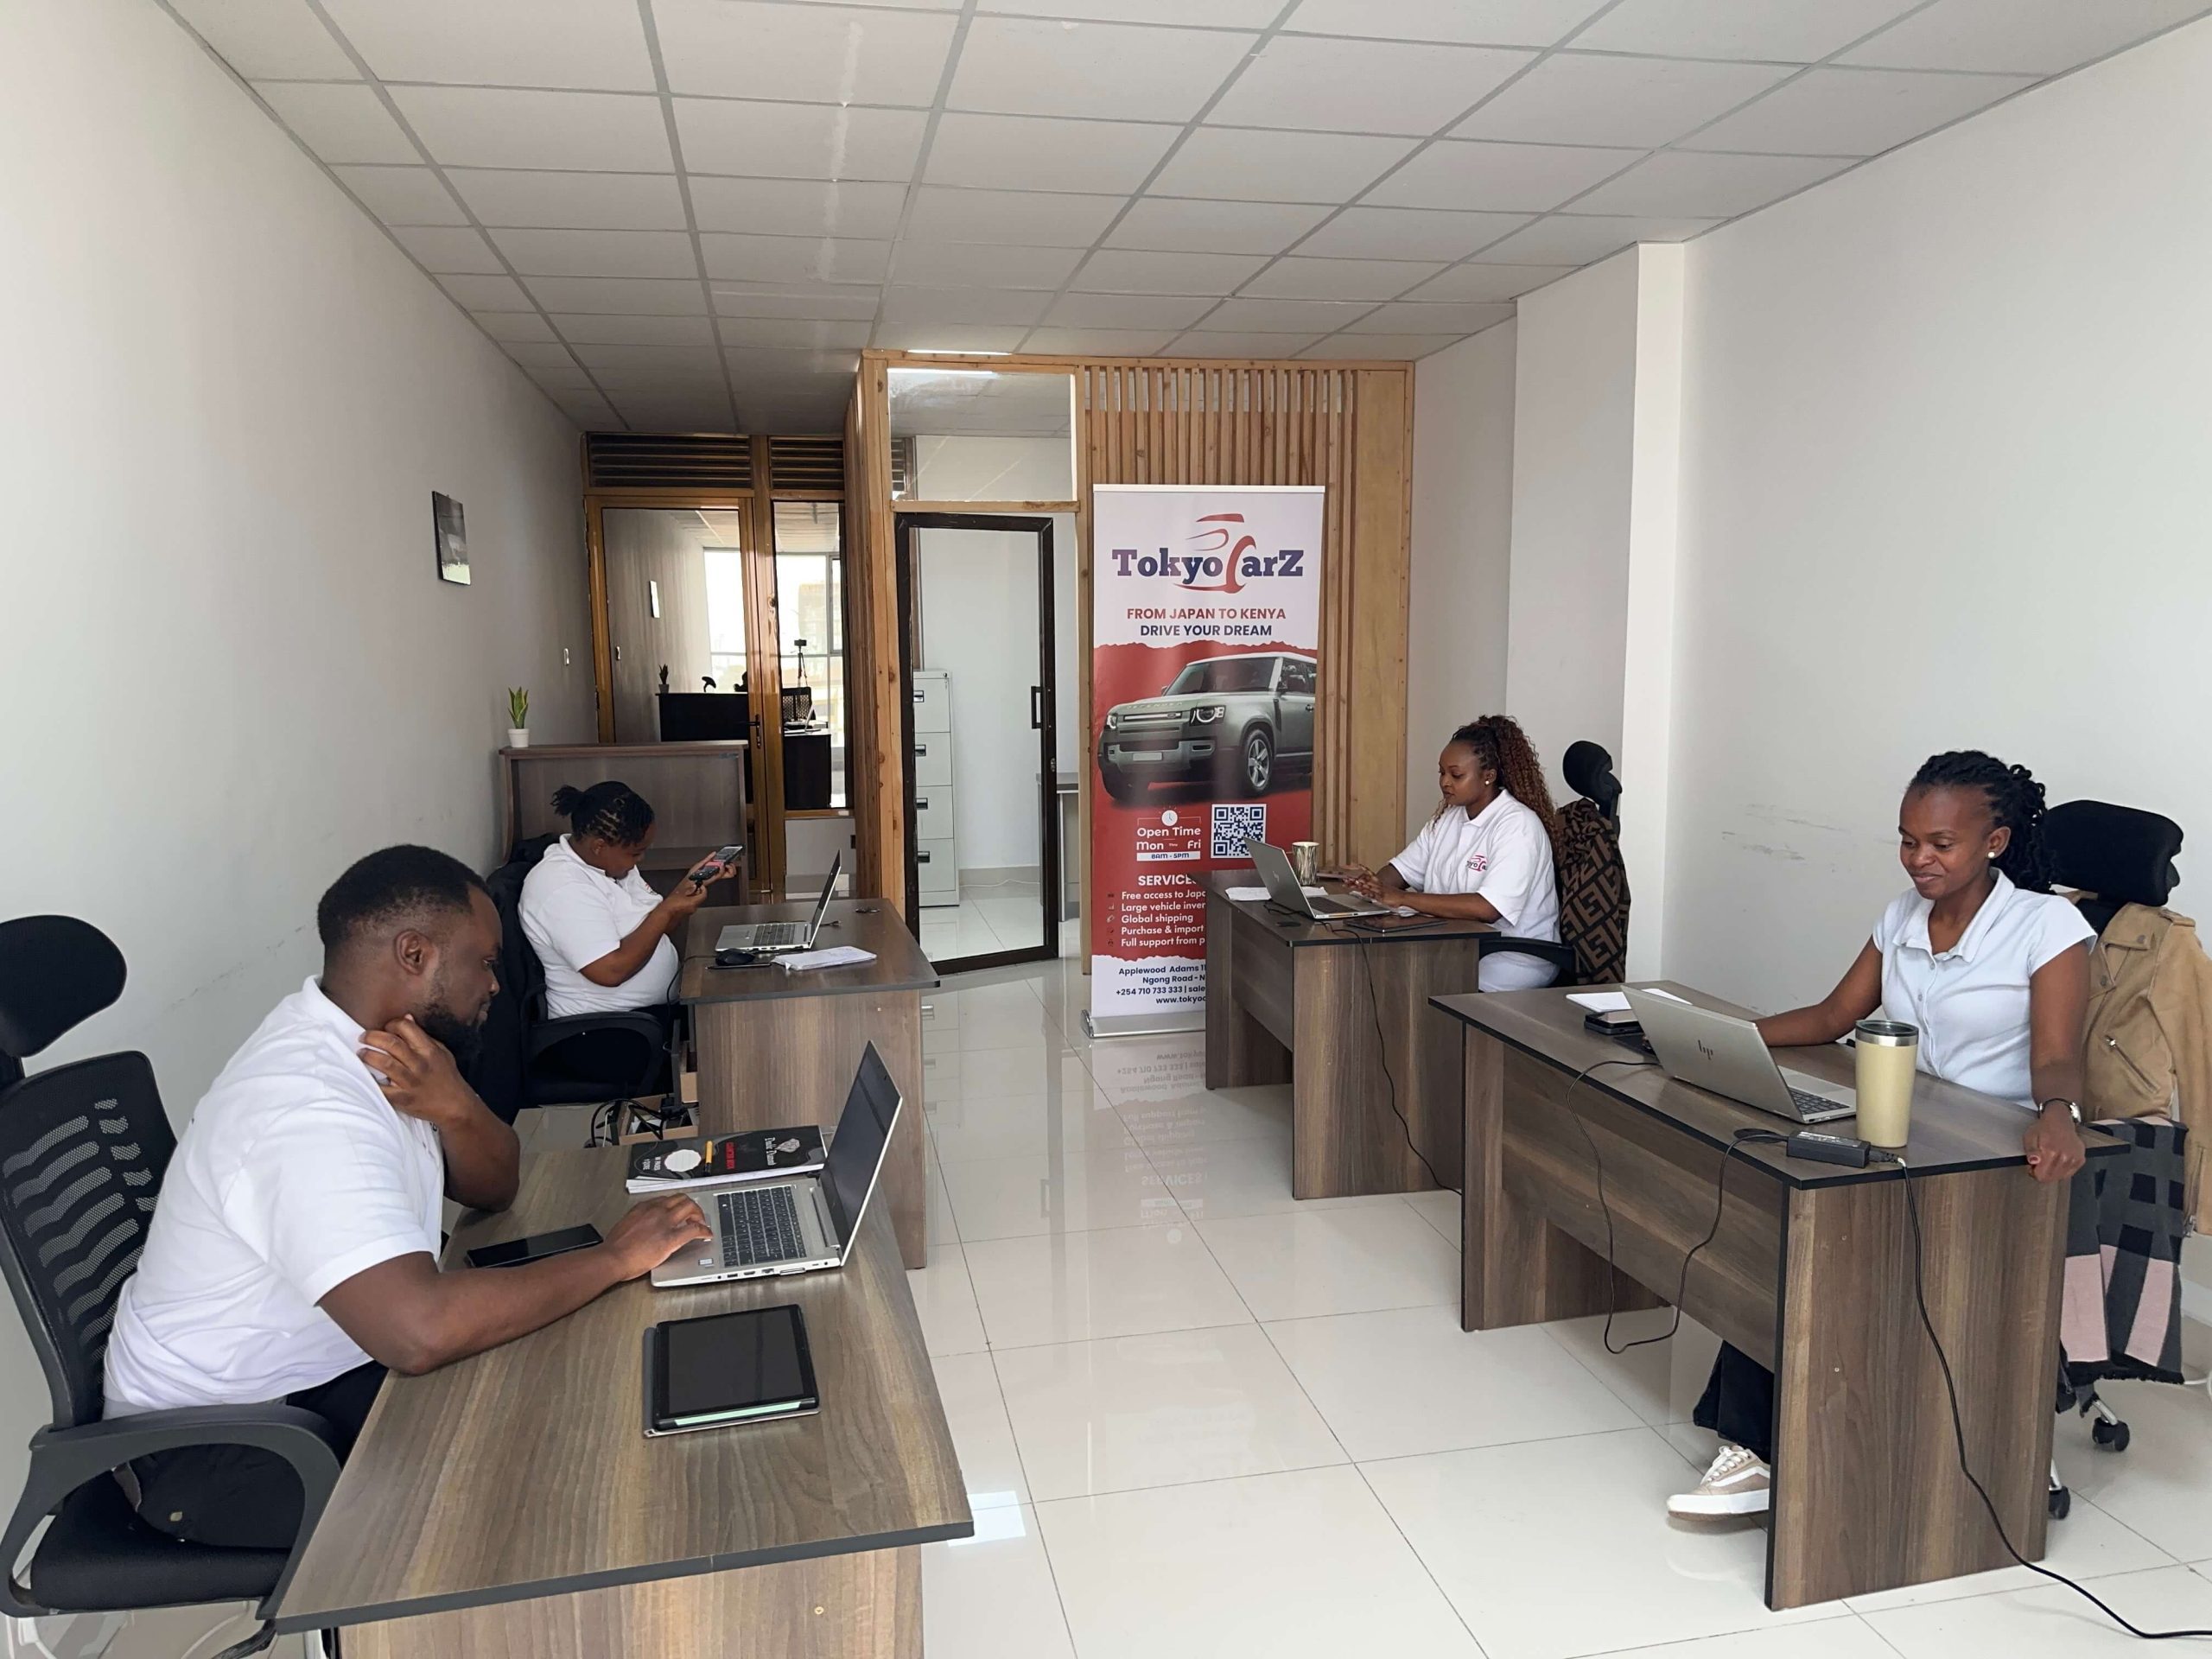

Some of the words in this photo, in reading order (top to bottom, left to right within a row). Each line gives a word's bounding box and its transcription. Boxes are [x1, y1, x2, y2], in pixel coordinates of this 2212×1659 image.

[1127, 608, 1166, 620] FROM
[1169, 608, 1215, 620] JAPAN
[1218, 608, 1237, 619] TO
[1240, 608, 1286, 620] KENYA
[1140, 625, 1180, 636] DRIVE
[1183, 625, 1220, 636] YOUR
[1224, 625, 1272, 636] DREAM
[1136, 827, 1169, 839] Open
[1172, 825, 1201, 836] Time
[1136, 840, 1164, 850] Mon
[1187, 839, 1201, 849] Fri
[1138, 874, 1197, 887] SERVICE
[1122, 891, 1141, 900] Free
[1122, 903, 1147, 913] Large
[1150, 901, 1181, 911] vehicle
[1122, 913, 1153, 924] Global
[1155, 913, 1193, 924] shipping
[1122, 925, 1162, 935] Purchase
[1174, 925, 1204, 935] import
[1122, 938, 1136, 947] Full
[1139, 938, 1173, 948] support
[1176, 936, 1197, 944] from
[1118, 966, 1166, 976] Applewood
[1142, 976, 1170, 985] Ngong
